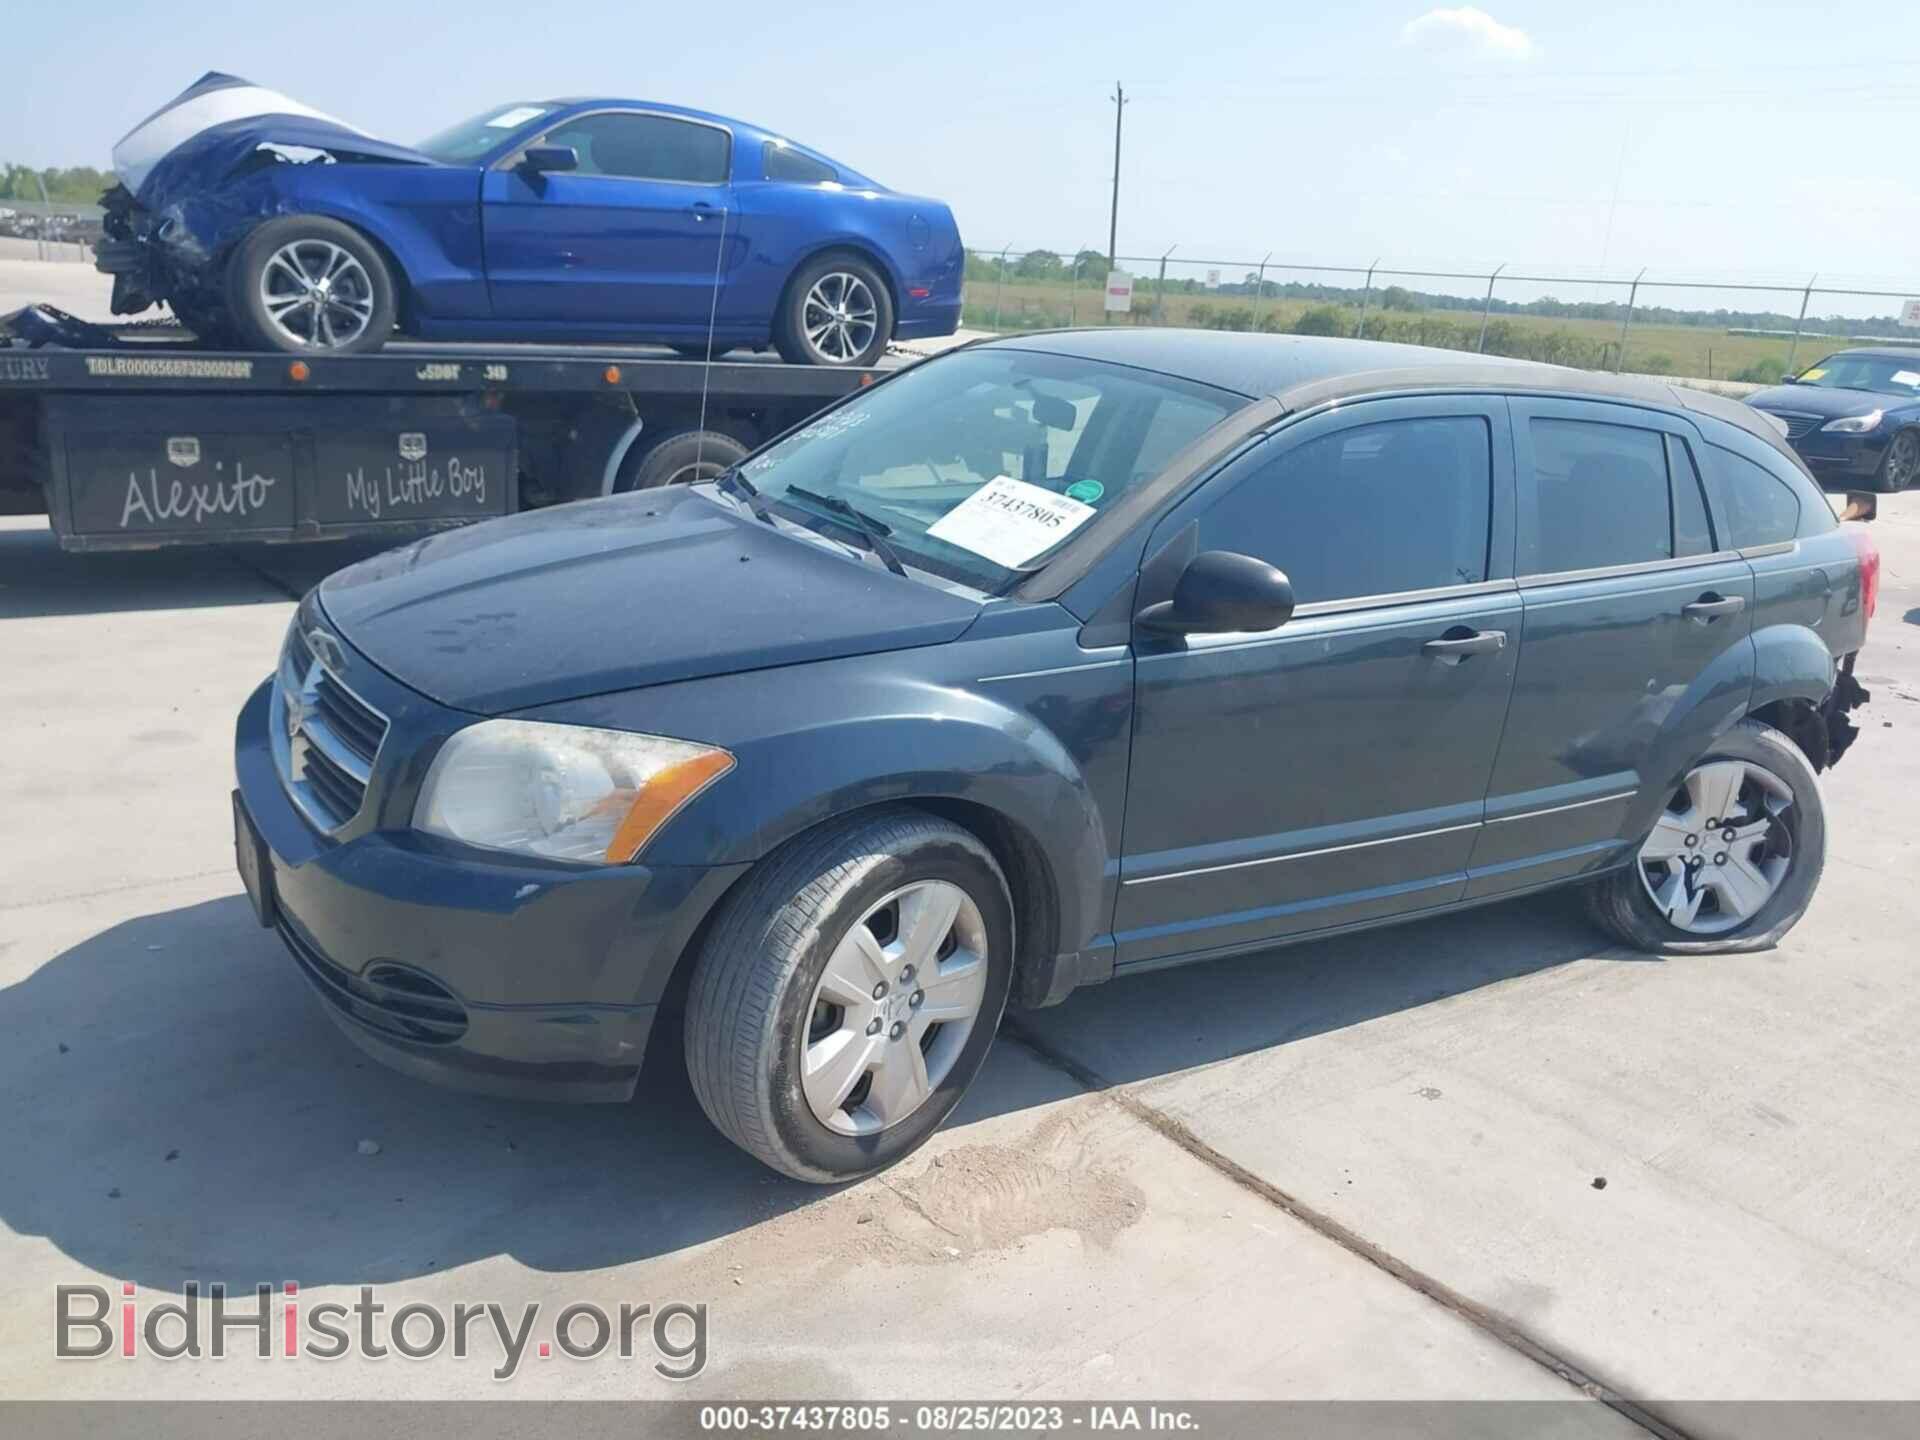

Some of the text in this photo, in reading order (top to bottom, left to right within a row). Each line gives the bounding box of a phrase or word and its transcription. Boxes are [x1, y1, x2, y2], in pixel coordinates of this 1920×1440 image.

[120, 460, 275, 527] Alexito
[347, 456, 486, 519] My Little Boy
[979, 491, 1066, 528] 37437805
